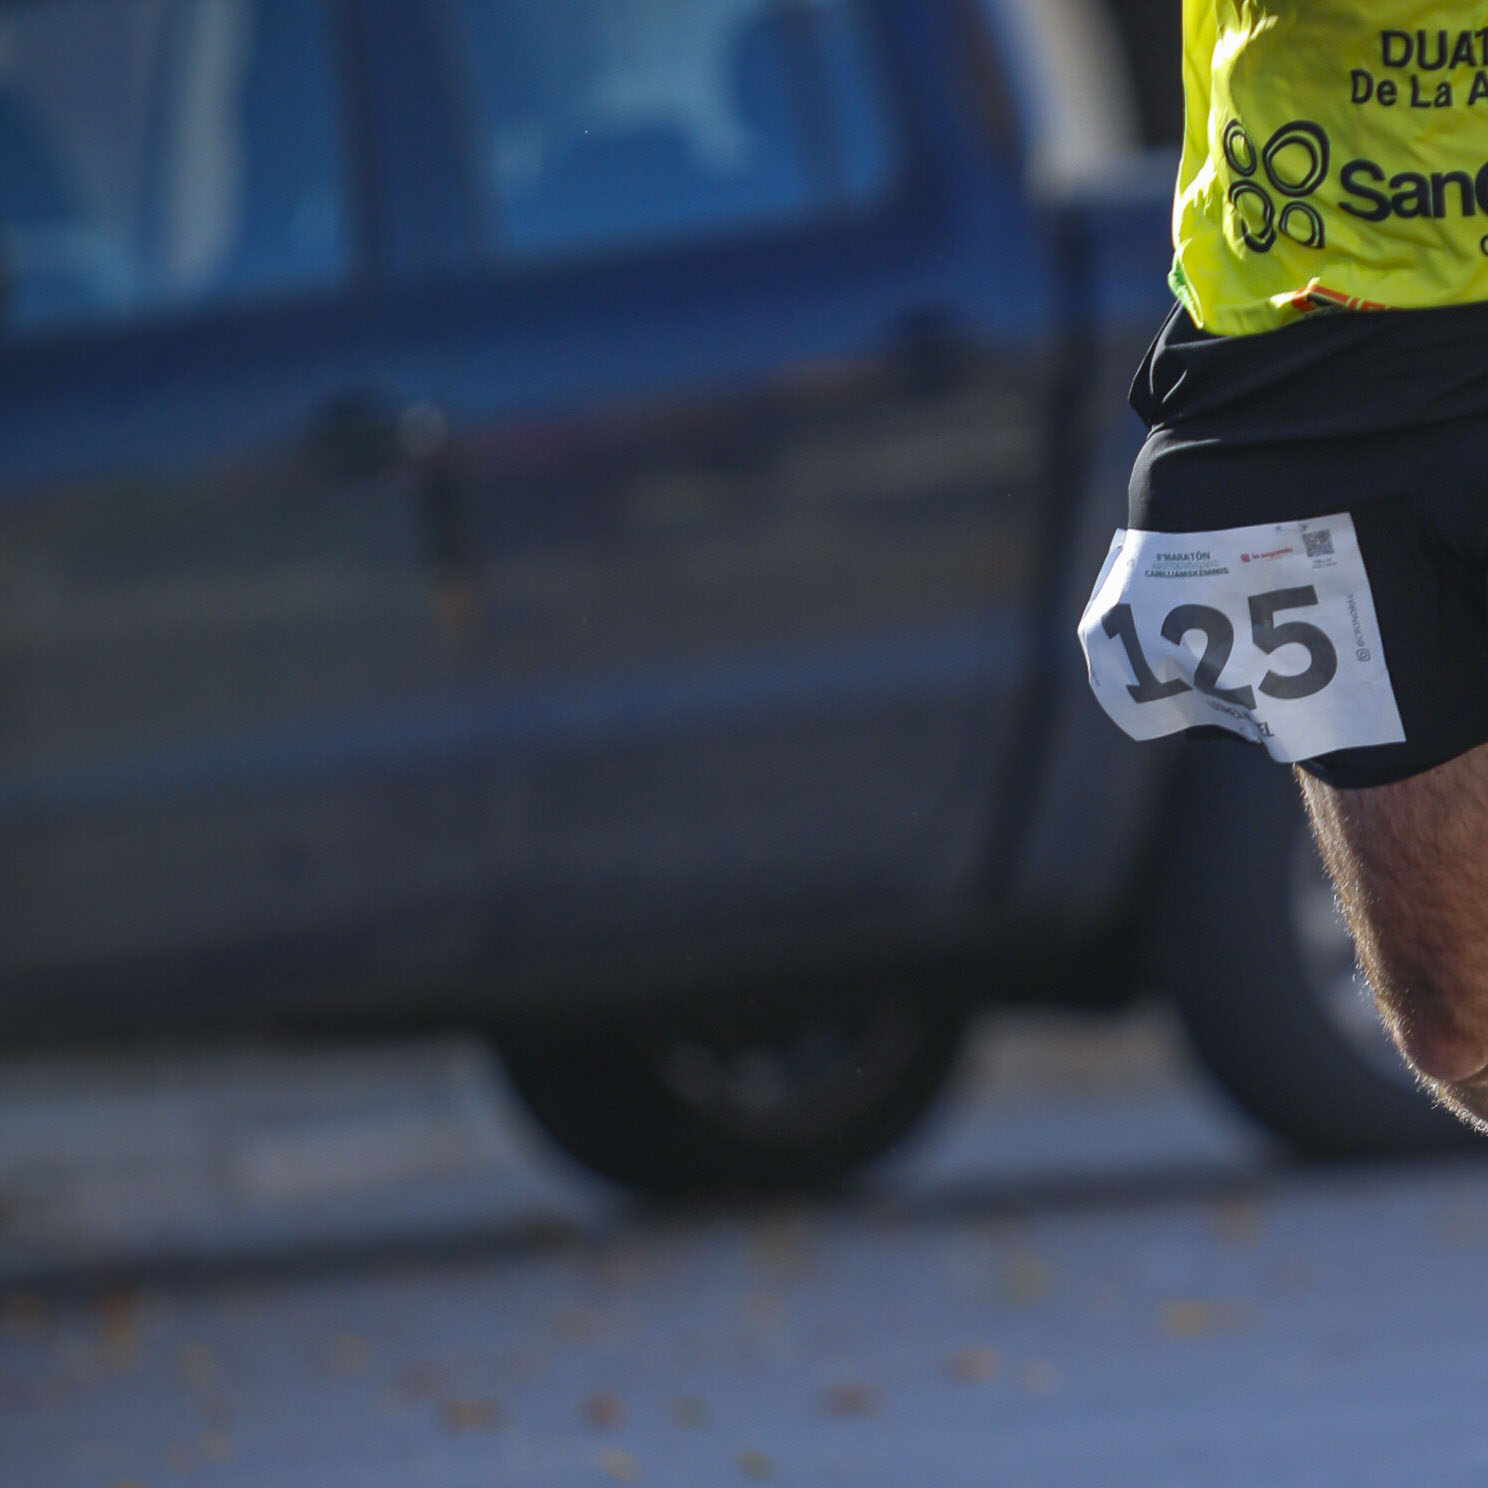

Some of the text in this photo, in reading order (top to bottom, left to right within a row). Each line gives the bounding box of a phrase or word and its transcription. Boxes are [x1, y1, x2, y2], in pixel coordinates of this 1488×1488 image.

[1351, 71, 1398, 105] De
[1410, 74, 1452, 108] La
[1101, 584, 1338, 710] 125
